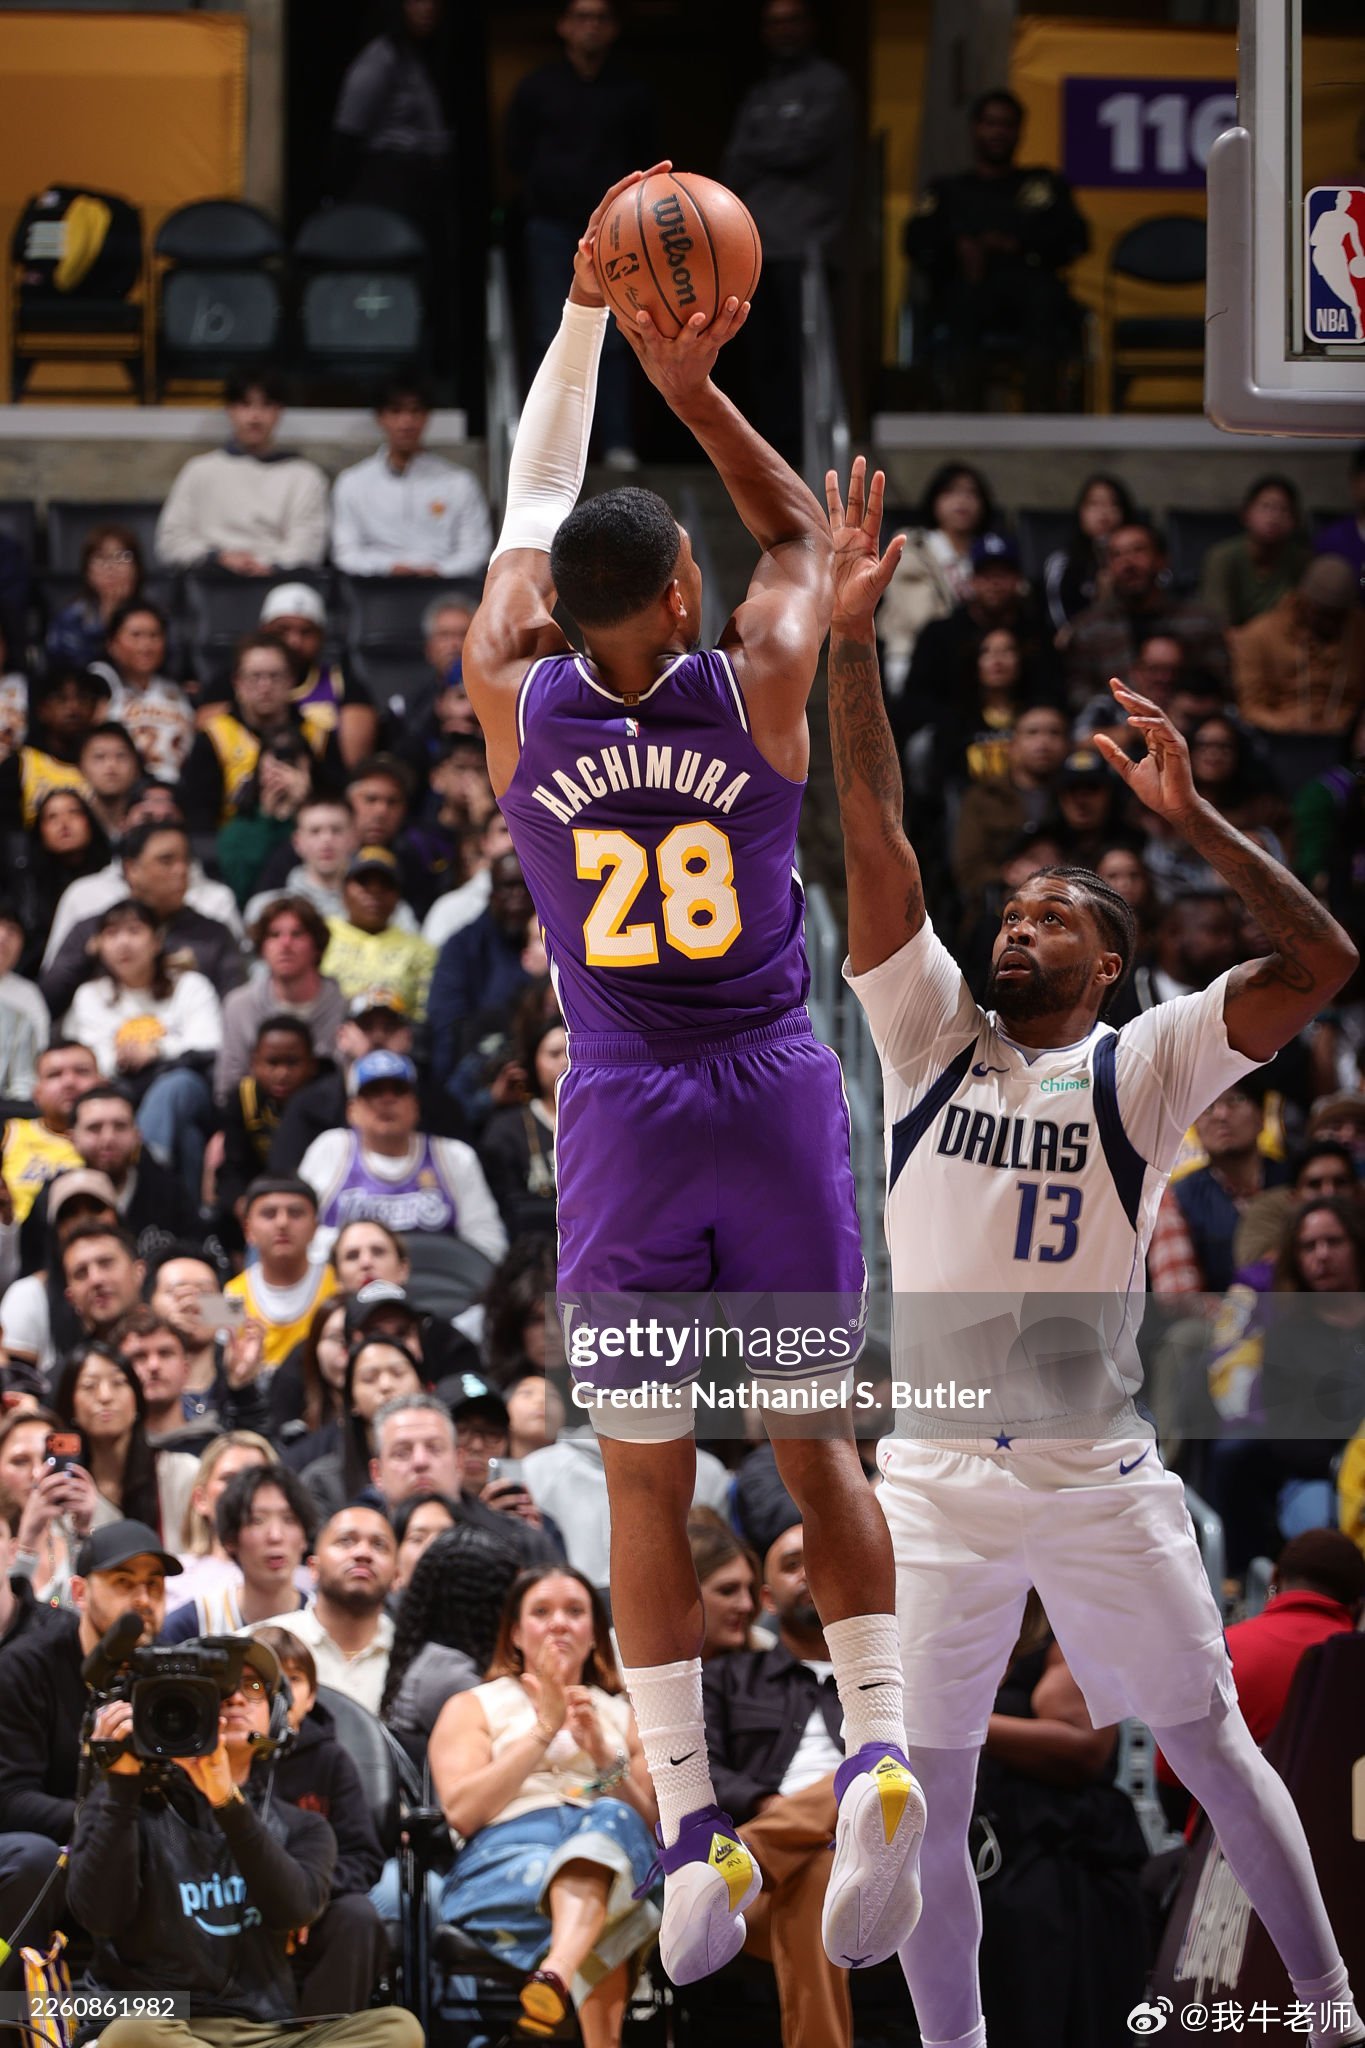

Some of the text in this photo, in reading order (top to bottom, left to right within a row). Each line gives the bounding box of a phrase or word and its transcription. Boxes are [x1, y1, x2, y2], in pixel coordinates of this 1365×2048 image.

[652, 193, 697, 307] Wilson
[1316, 308, 1349, 333] NBA
[531, 744, 751, 825] HACHIMURA
[572, 820, 743, 967] 28
[1040, 1076, 1091, 1092] Chime
[935, 1102, 1090, 1173] DALLAS
[1013, 1179, 1084, 1264] 13
[179, 1872, 247, 1917] prim
